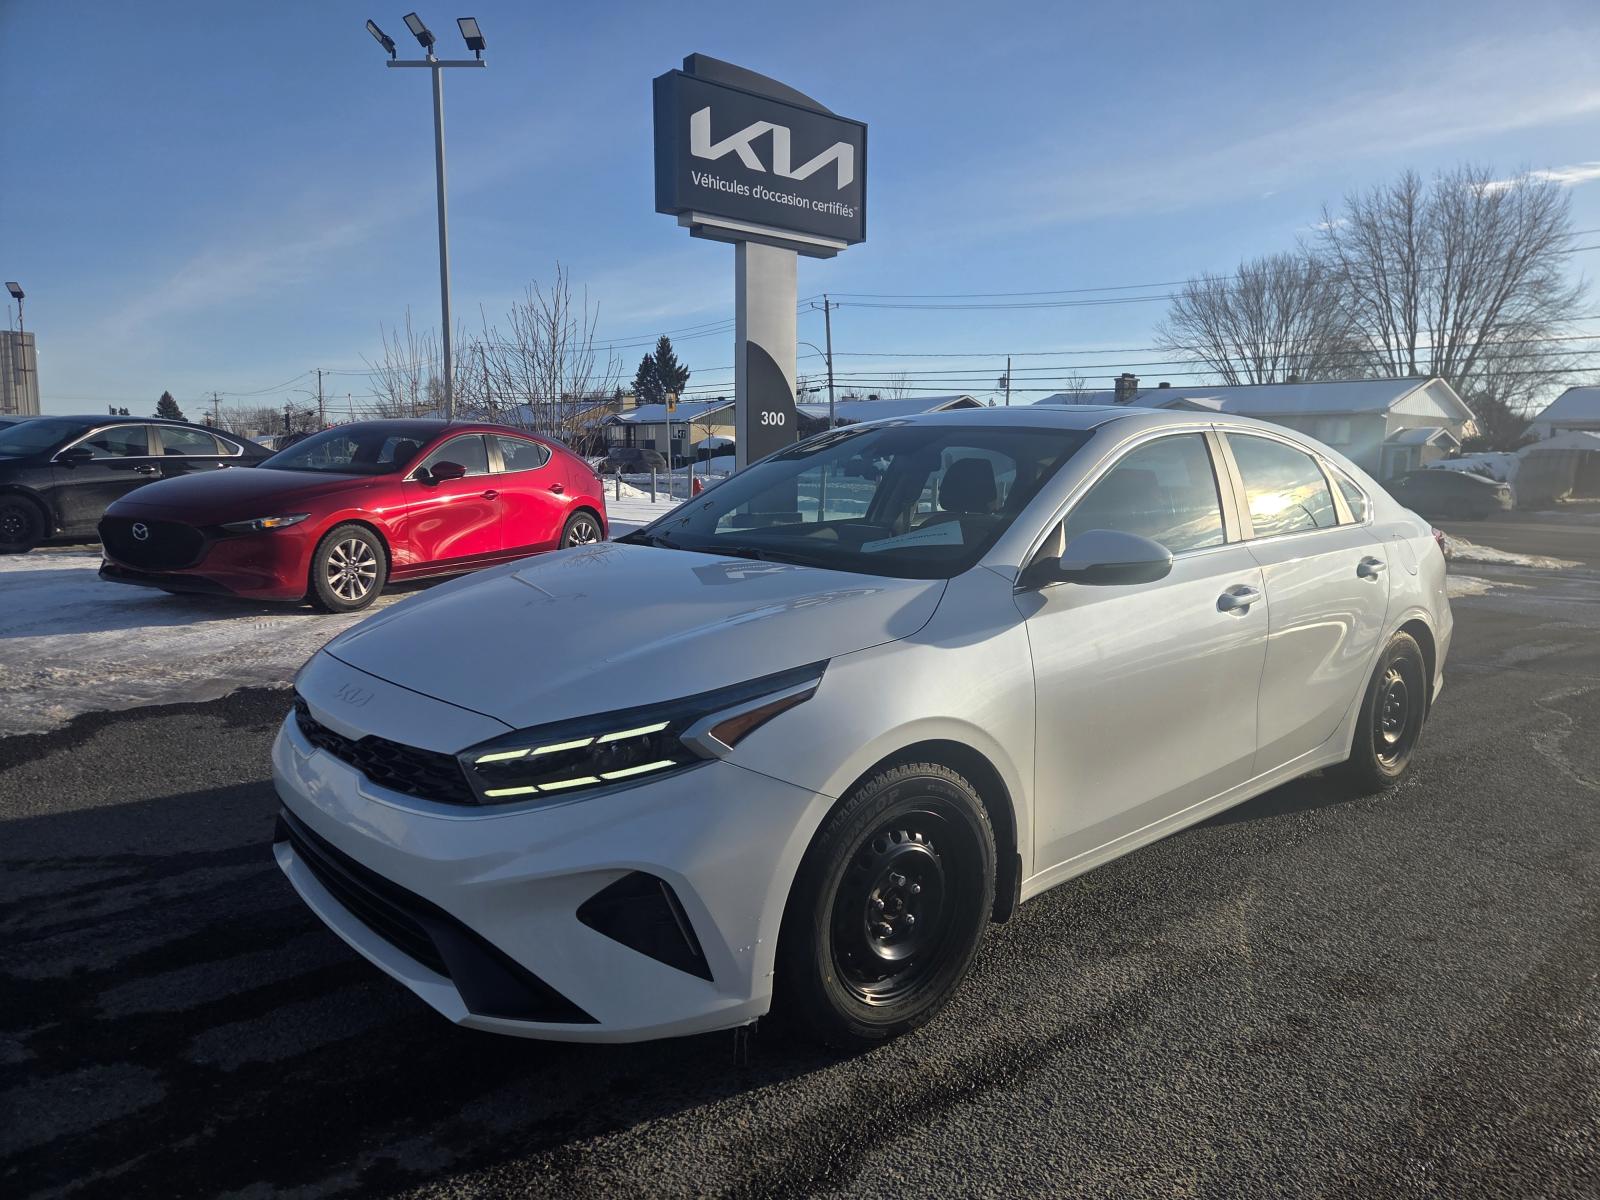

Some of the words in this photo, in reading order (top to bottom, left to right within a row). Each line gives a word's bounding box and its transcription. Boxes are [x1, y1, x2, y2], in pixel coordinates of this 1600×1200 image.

[690, 106, 854, 190] KIA
[691, 170, 750, 196] Véhicules
[752, 185, 810, 209] d'occasion
[812, 198, 854, 218] certifiés
[760, 411, 785, 426] 300
